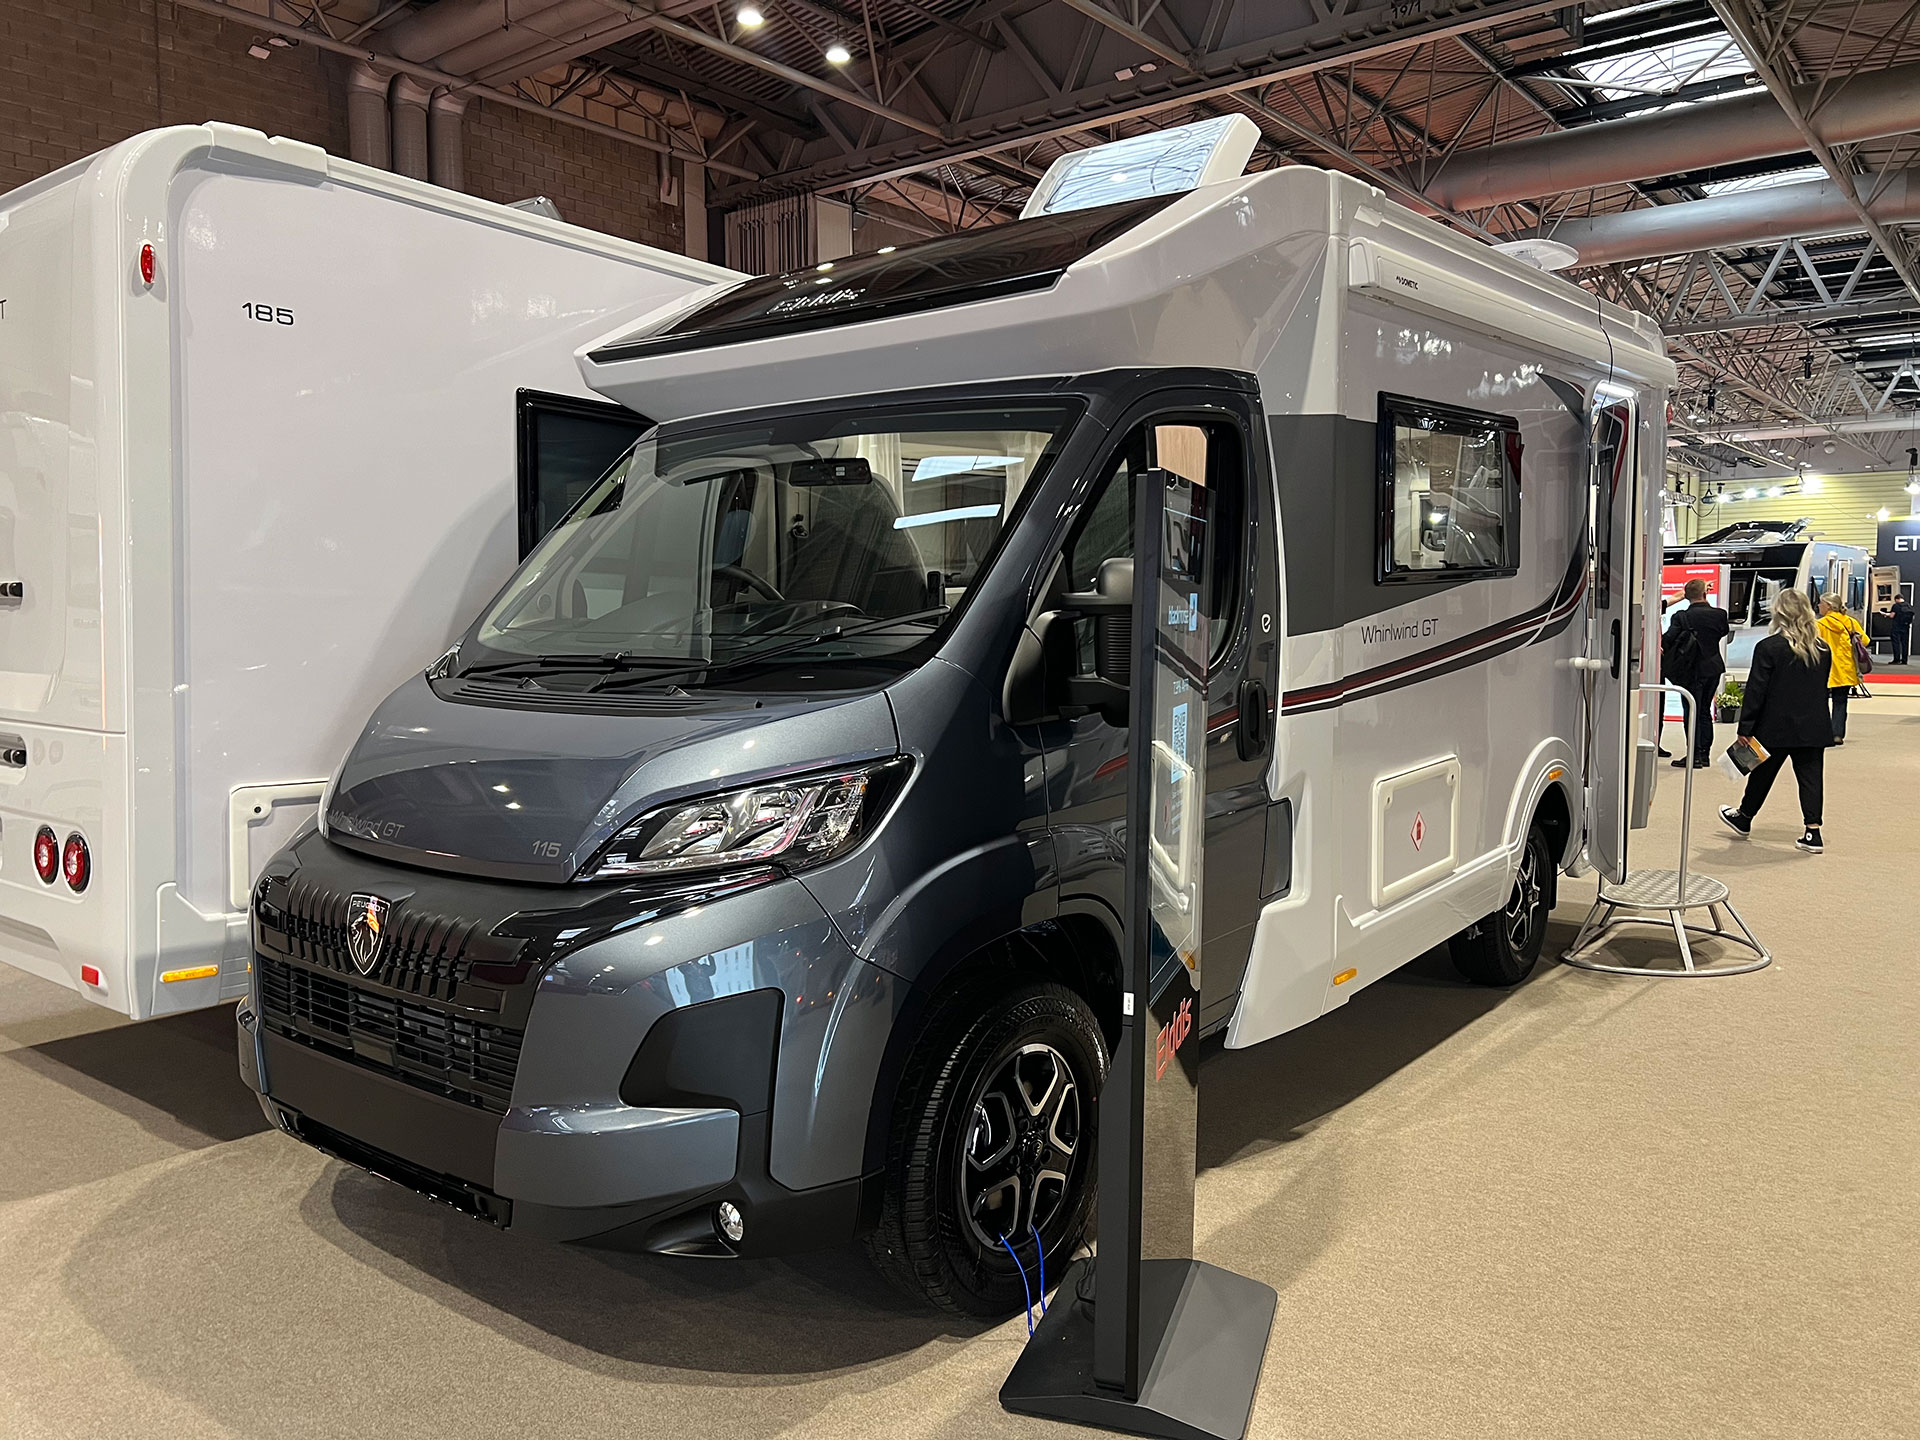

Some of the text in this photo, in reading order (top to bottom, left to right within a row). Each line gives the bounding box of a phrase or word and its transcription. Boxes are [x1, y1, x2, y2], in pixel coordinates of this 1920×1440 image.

[1392, 1, 1421, 19] 19/1
[367, 50, 376, 62] 3
[241, 302, 294, 326] 185
[1361, 618, 1439, 645] Whirlwind GT
[383, 822, 405, 839] GT
[532, 840, 562, 858] 115
[352, 900, 386, 914] PEUGOT
